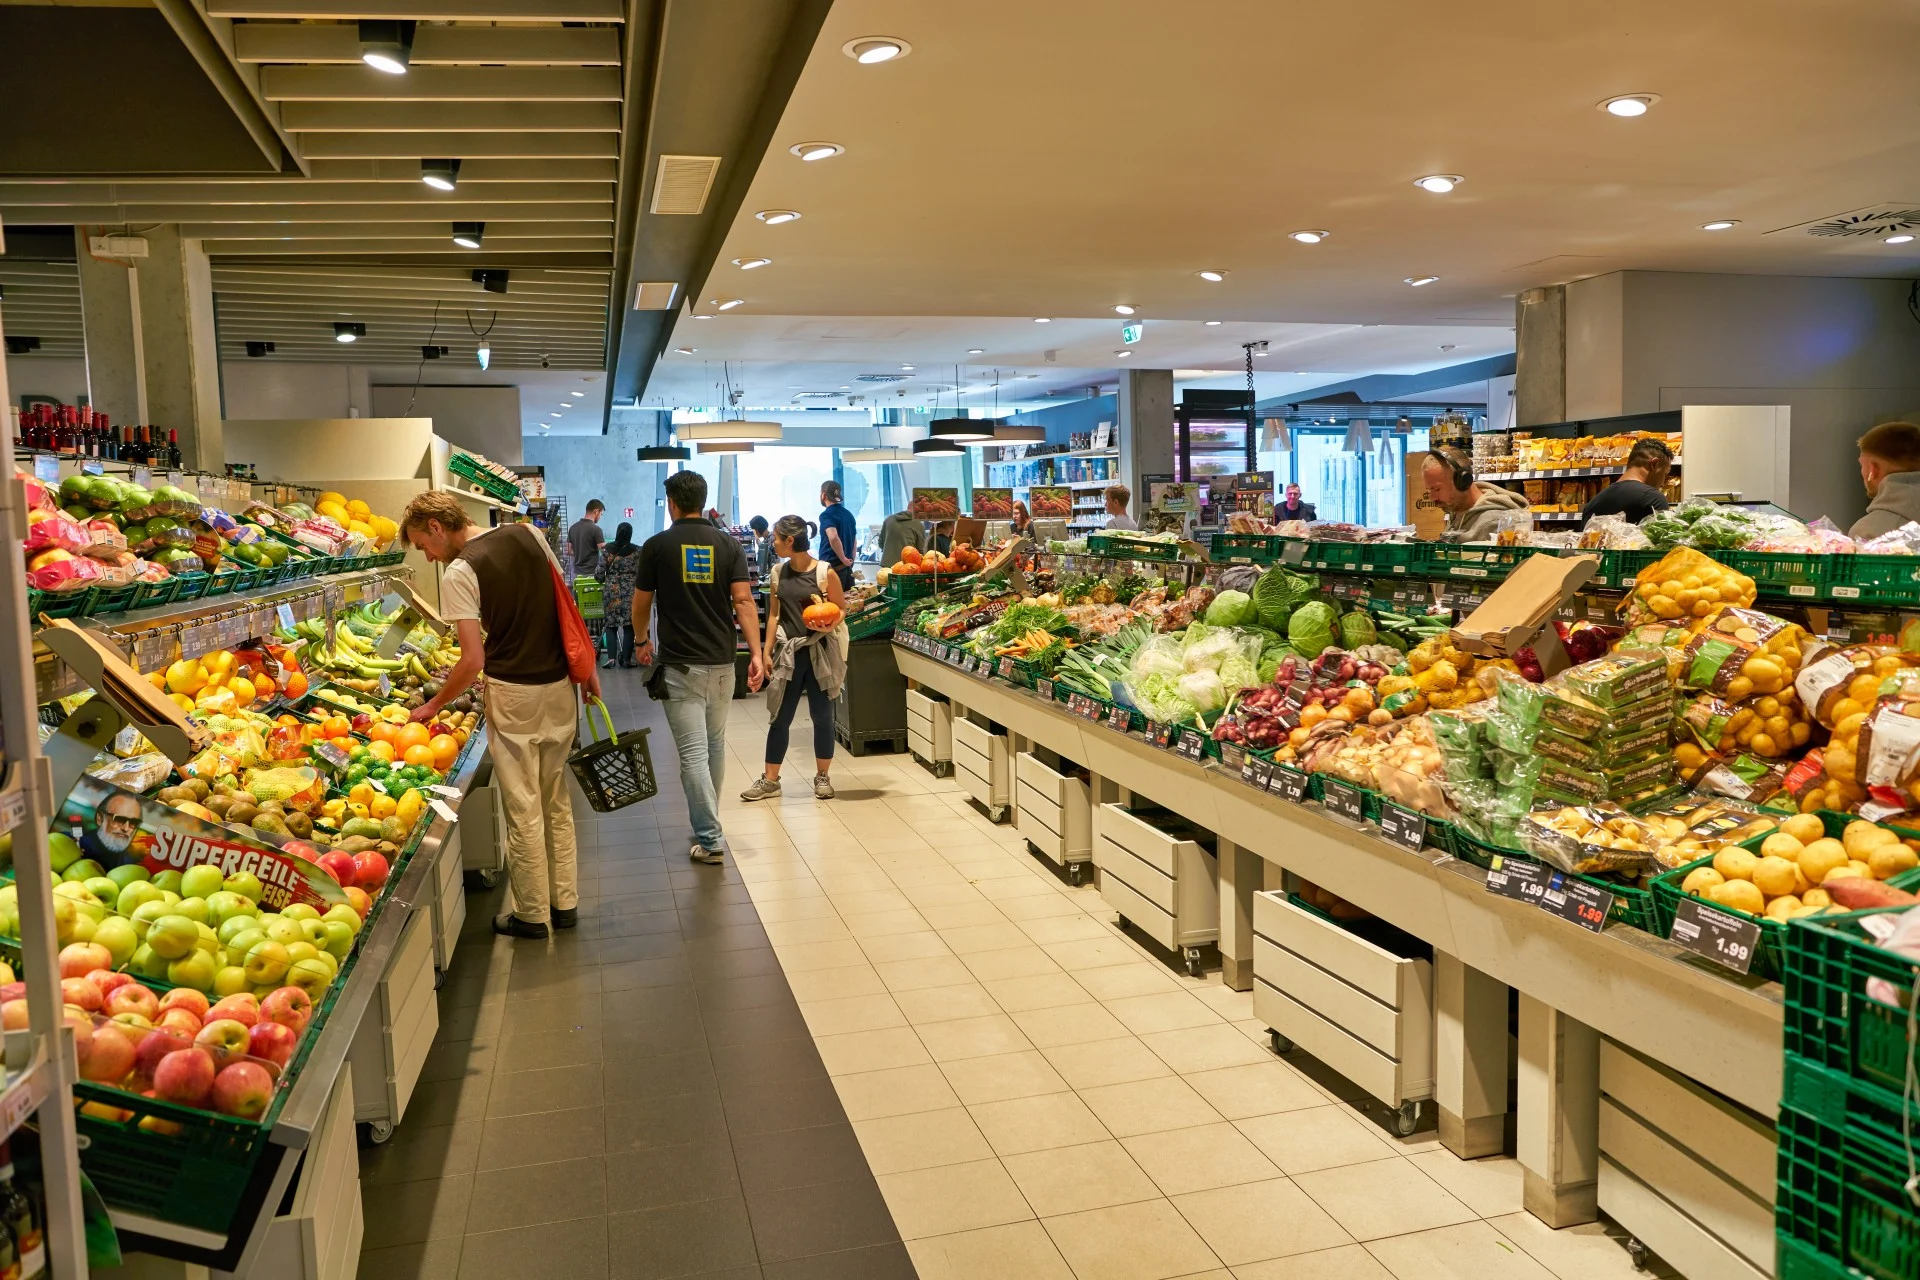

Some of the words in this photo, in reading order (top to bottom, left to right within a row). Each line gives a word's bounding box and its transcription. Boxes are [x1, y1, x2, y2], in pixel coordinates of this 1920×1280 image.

[1558, 608, 1573, 616] 1.49
[1867, 632, 1894, 644] 1.99
[1287, 786, 1300, 797] 1.79
[1345, 802, 1359, 815] 1.49
[1404, 830, 1420, 843] 1.99
[150, 824, 300, 892] SUPERGEILE
[1520, 881, 1544, 896] 1.99
[1577, 904, 1602, 923] 1.99
[1697, 906, 1742, 928] Speisekartoffeln
[1716, 937, 1748, 960] 1.99
